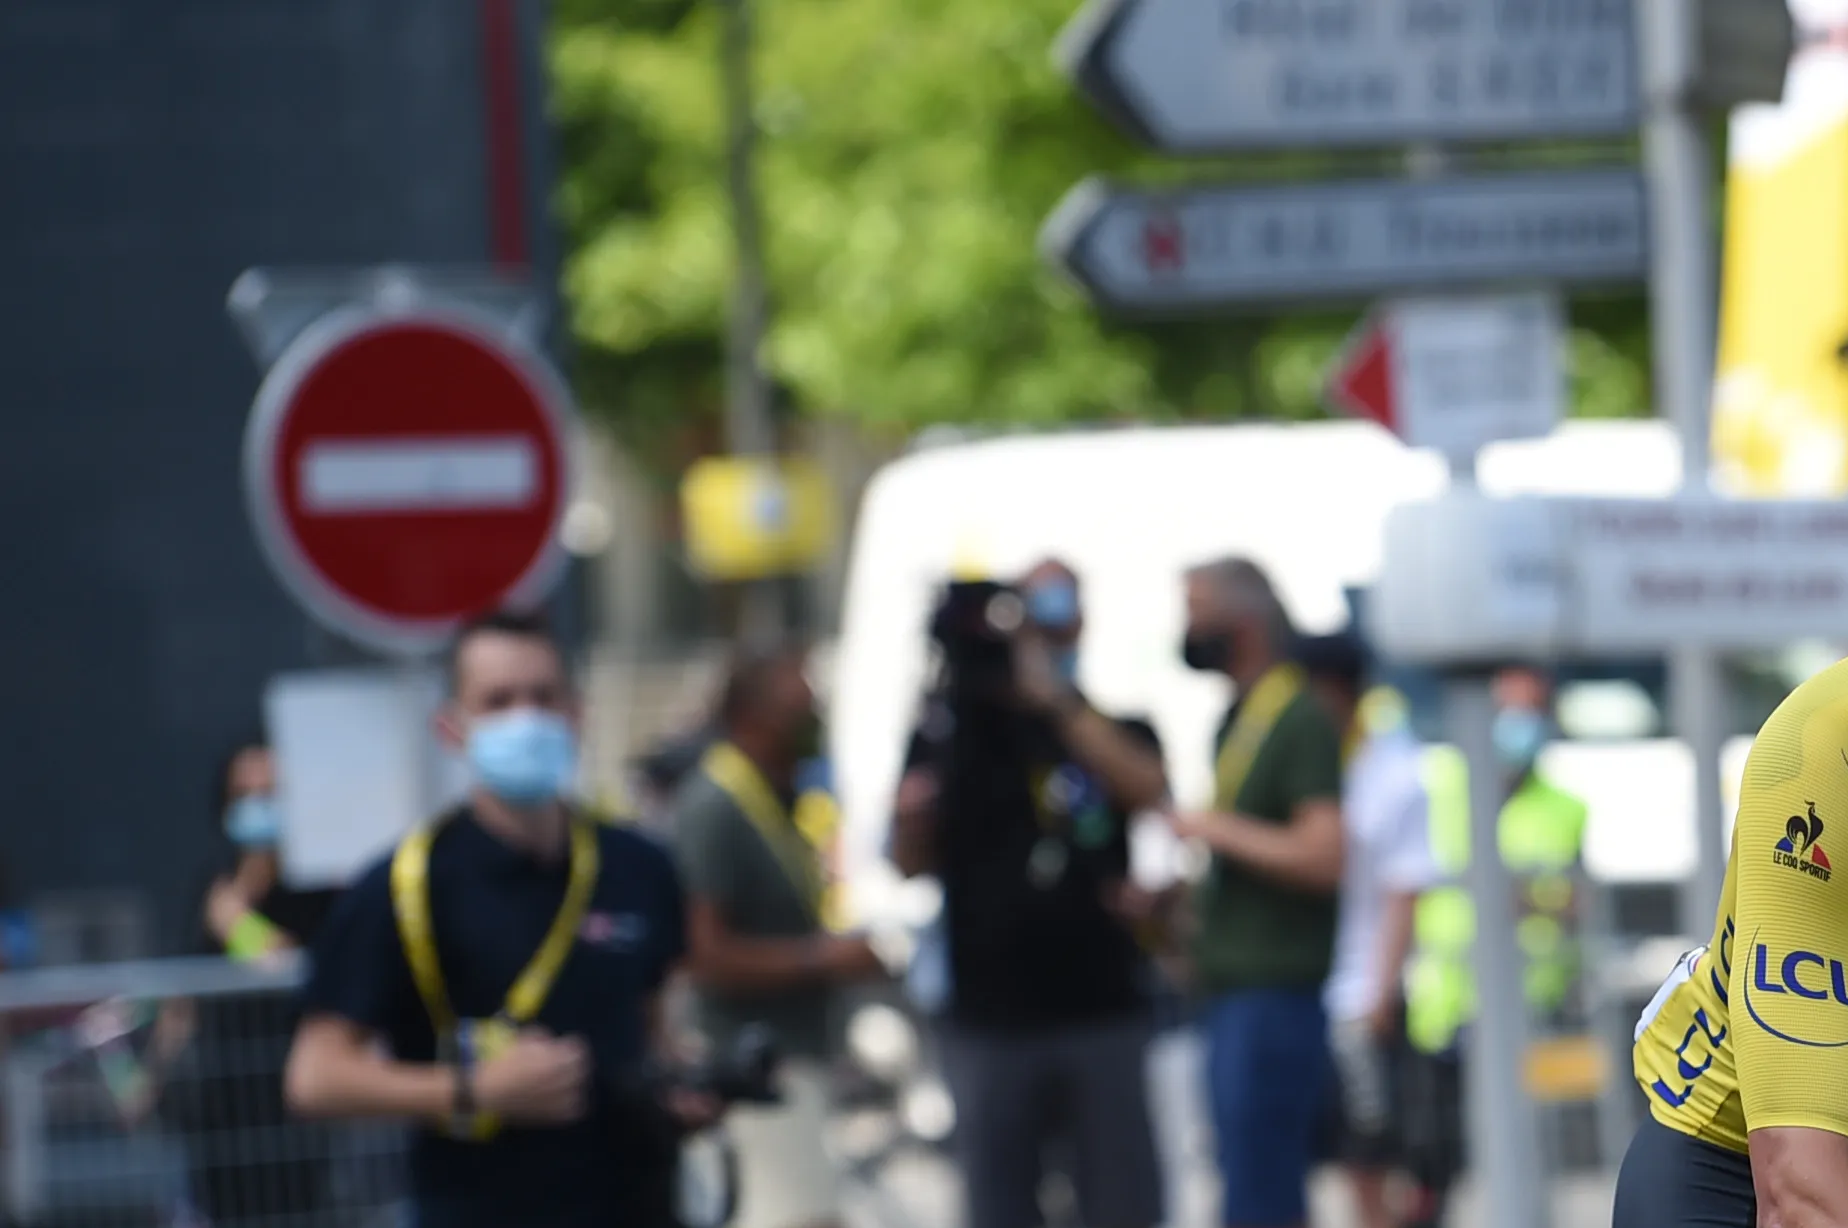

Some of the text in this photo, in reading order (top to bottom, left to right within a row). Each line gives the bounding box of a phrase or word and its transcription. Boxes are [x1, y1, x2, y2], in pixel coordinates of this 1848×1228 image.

[1773, 850, 1832, 882] LE COQ SPORTIF
[1651, 1008, 1727, 1108] LCL
